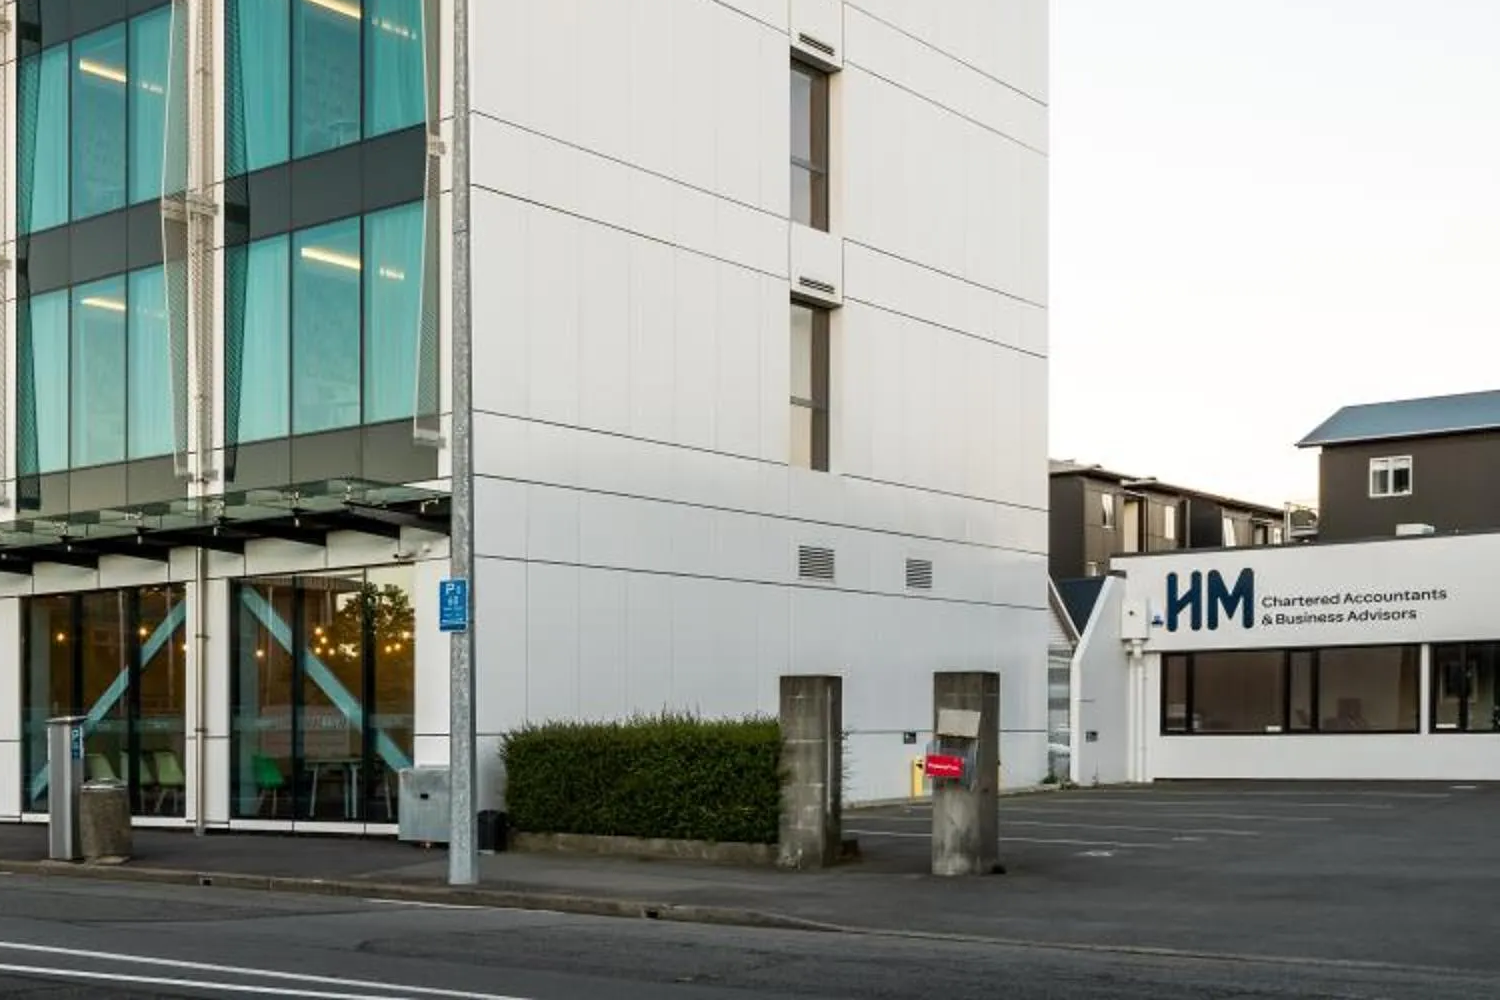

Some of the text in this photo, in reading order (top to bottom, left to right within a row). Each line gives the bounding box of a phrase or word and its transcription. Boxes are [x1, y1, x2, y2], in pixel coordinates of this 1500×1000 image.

[1166, 567, 1255, 632] HM
[1261, 588, 1448, 609] Chartered Accountants
[1261, 607, 1418, 627] & Business Advisors
